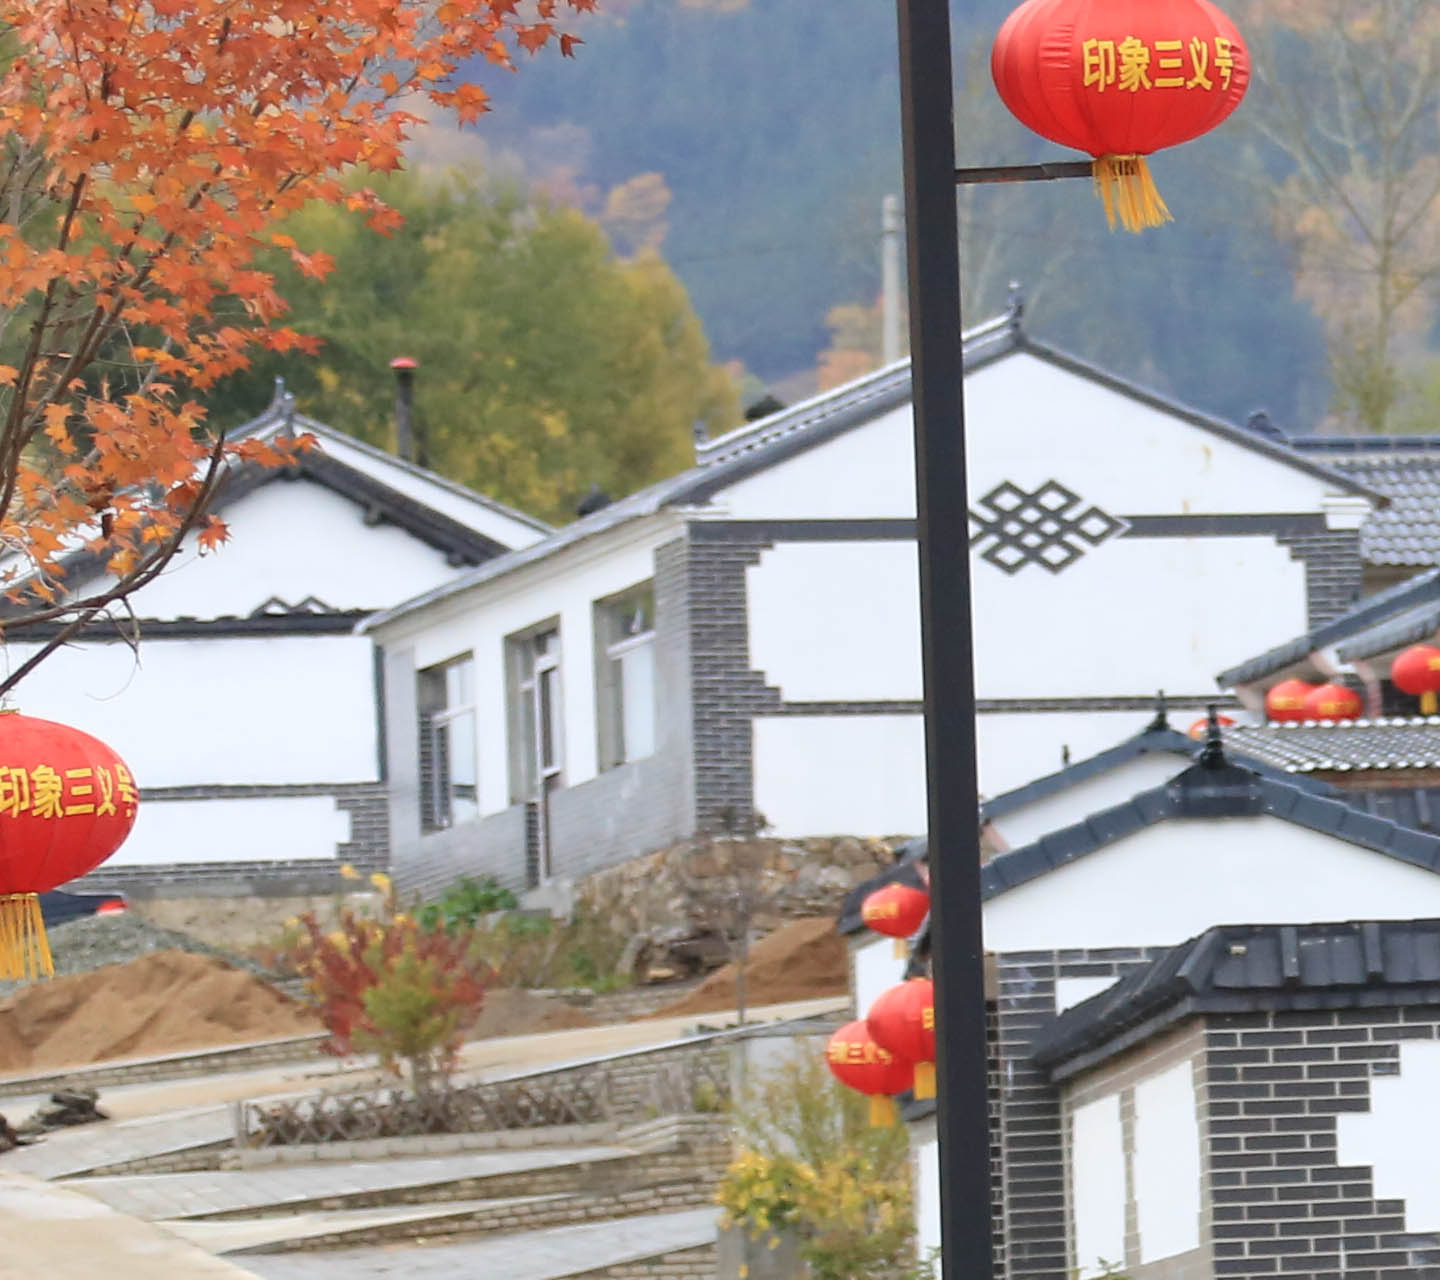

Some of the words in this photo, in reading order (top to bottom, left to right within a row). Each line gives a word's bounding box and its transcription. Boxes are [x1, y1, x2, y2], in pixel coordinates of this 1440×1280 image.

[1082, 36, 1235, 93] 印象三义号
